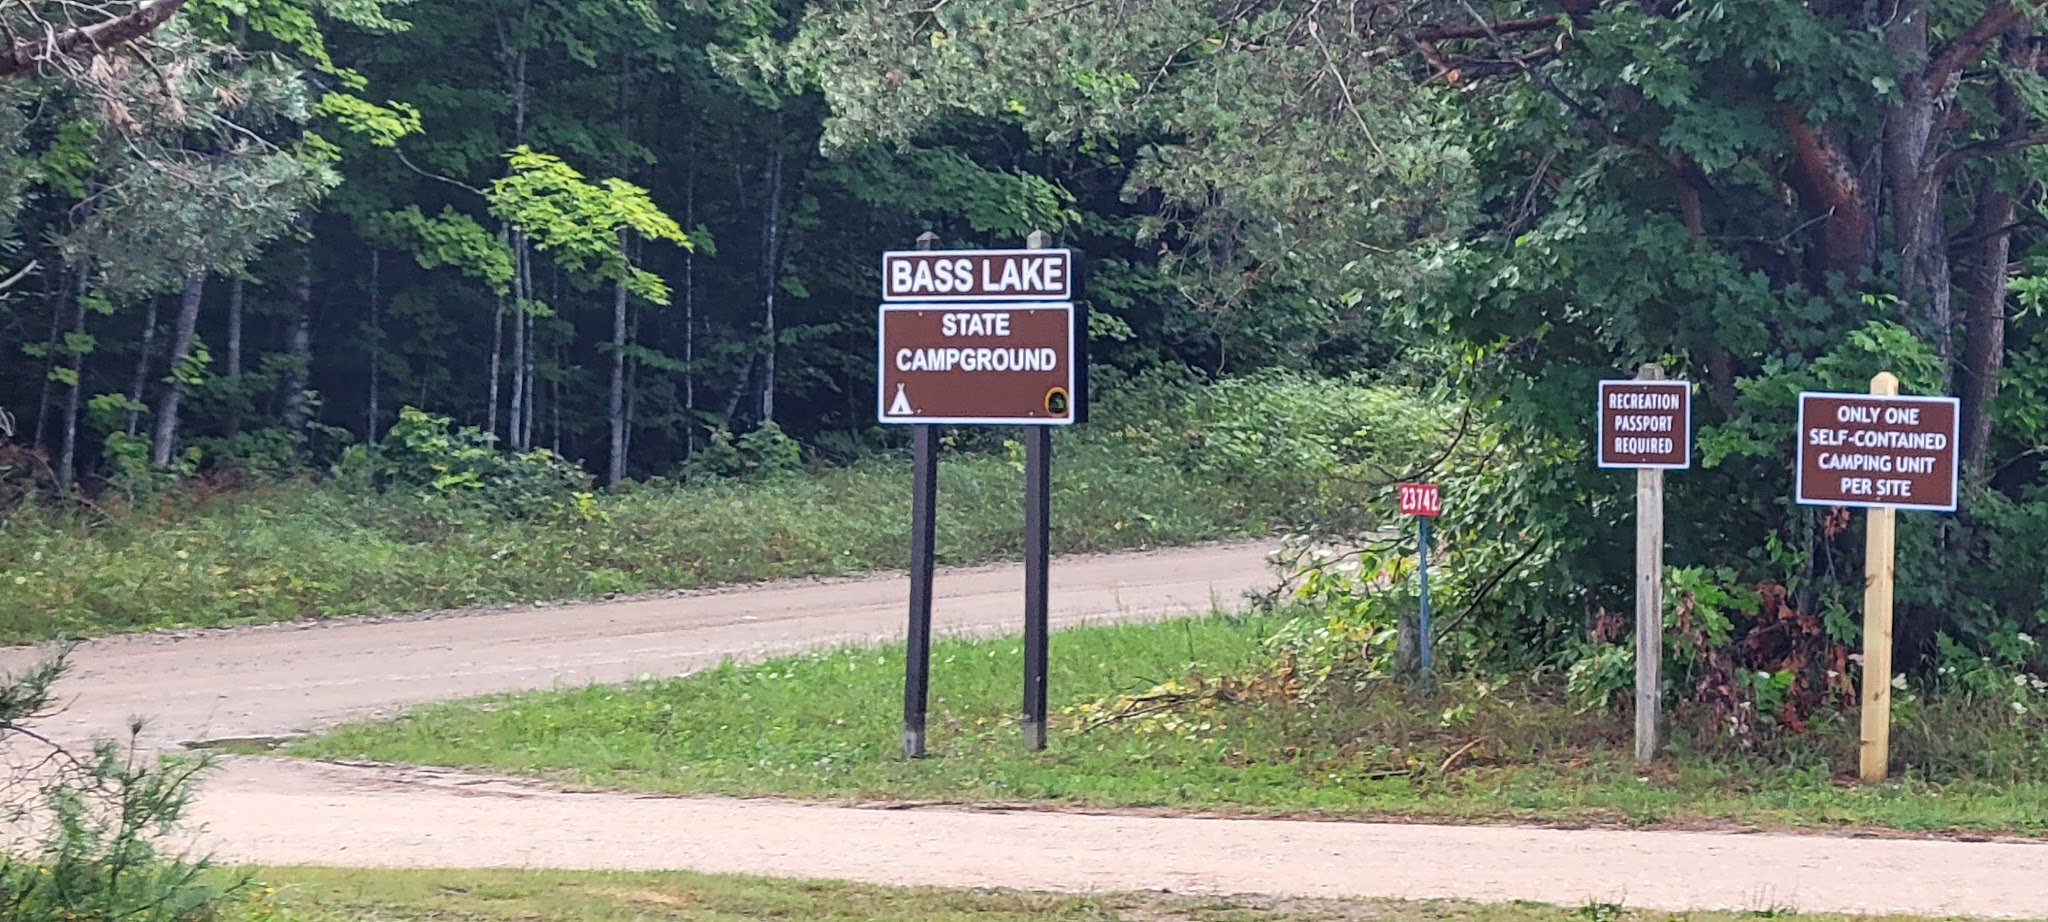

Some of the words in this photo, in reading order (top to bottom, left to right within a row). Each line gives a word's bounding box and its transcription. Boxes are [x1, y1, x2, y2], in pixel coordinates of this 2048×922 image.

[892, 259, 974, 292] BASS
[982, 258, 1063, 291] LAKE
[942, 313, 1011, 336] STATE
[896, 348, 1057, 371] CAMPGROUND
[1609, 393, 1680, 410] RECREATION
[1615, 415, 1673, 432] PASSPORT
[1837, 406, 1881, 423] ONLY
[1885, 408, 1920, 425] ONE
[1614, 437, 1674, 454] REQUIRED
[1809, 428, 1947, 450] SELF-CONTAINED
[1818, 453, 1892, 472] CAMPING
[1896, 457, 1936, 474] UNIT
[1841, 477, 1872, 495] PER
[1876, 480, 1912, 497] SITE
[1401, 487, 1438, 511] 23742
